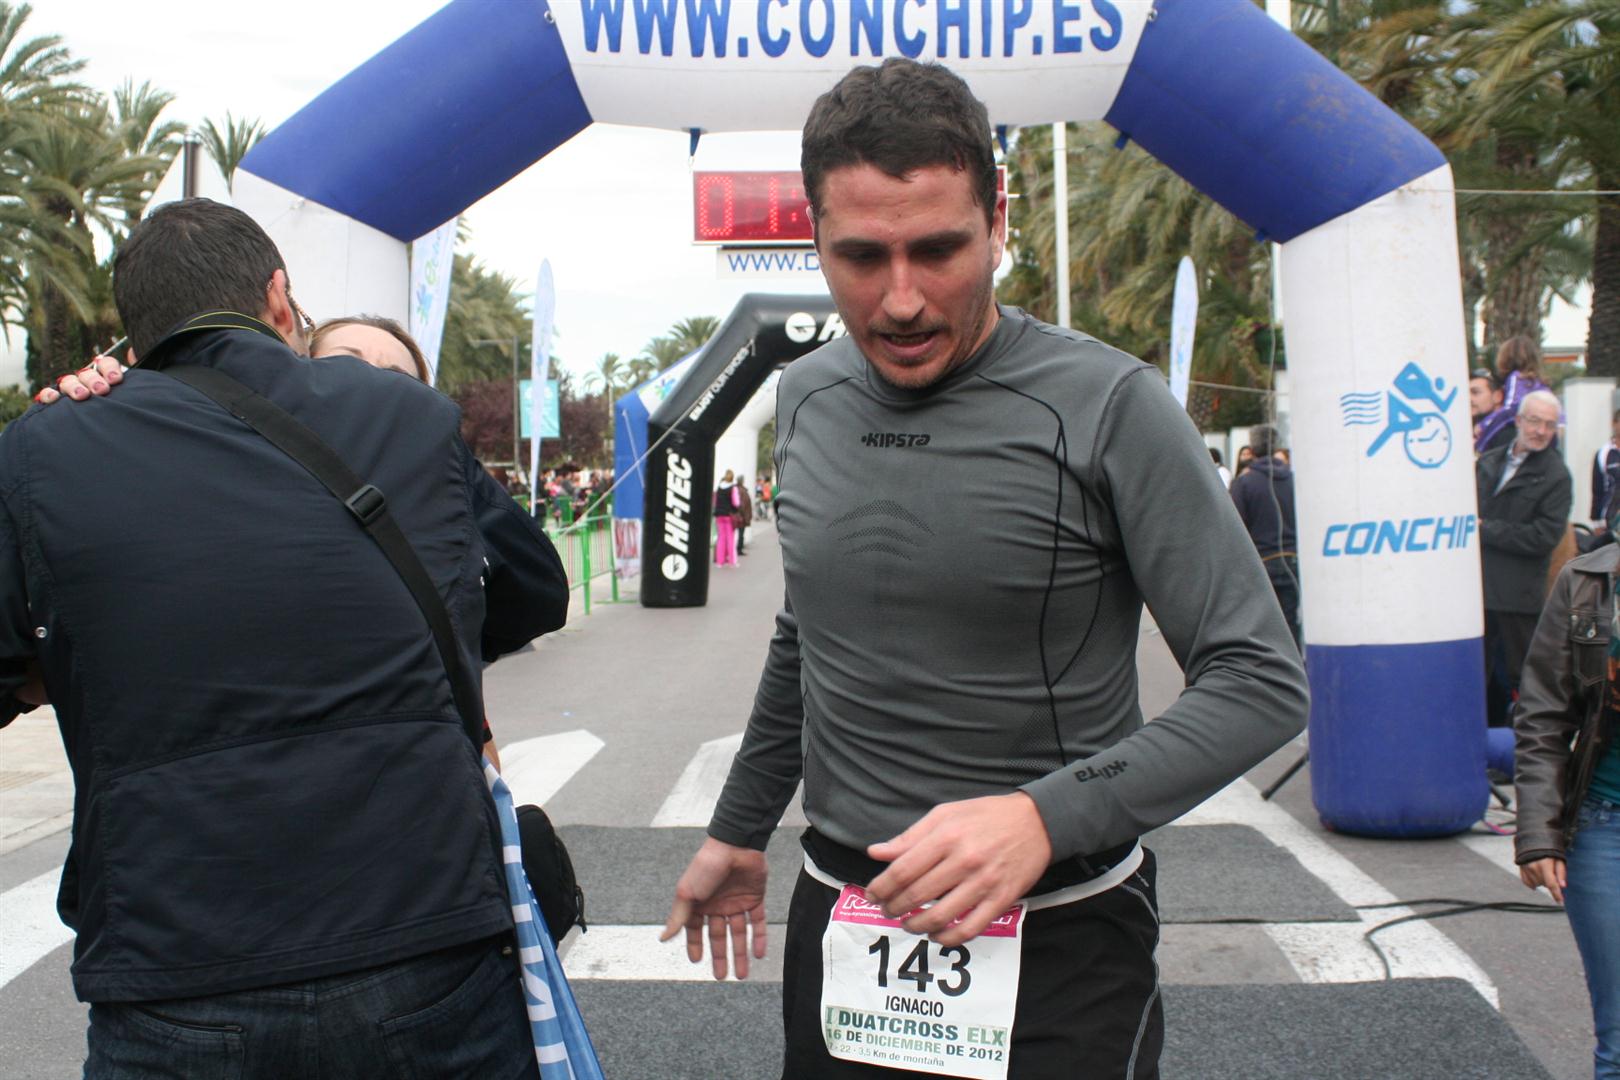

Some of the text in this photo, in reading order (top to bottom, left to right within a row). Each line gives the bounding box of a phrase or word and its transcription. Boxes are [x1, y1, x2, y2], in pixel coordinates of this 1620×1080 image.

[582, 0, 1122, 57] WWW.CONCHIP.ES
[664, 452, 692, 554] HI-TEC
[1322, 513, 1476, 557] CONCHIP
[868, 935, 972, 997] 143
[885, 995, 944, 1018] IGNACIO
[826, 1028, 1003, 1061] 16 DE DICIEMBRE DE 2012
[838, 1010, 958, 1041] DUATCROSS
[967, 1027, 1005, 1047] ELX
[873, 1048, 887, 1059] Km
[889, 1051, 901, 1061] de
[903, 1054, 945, 1067] montaña
